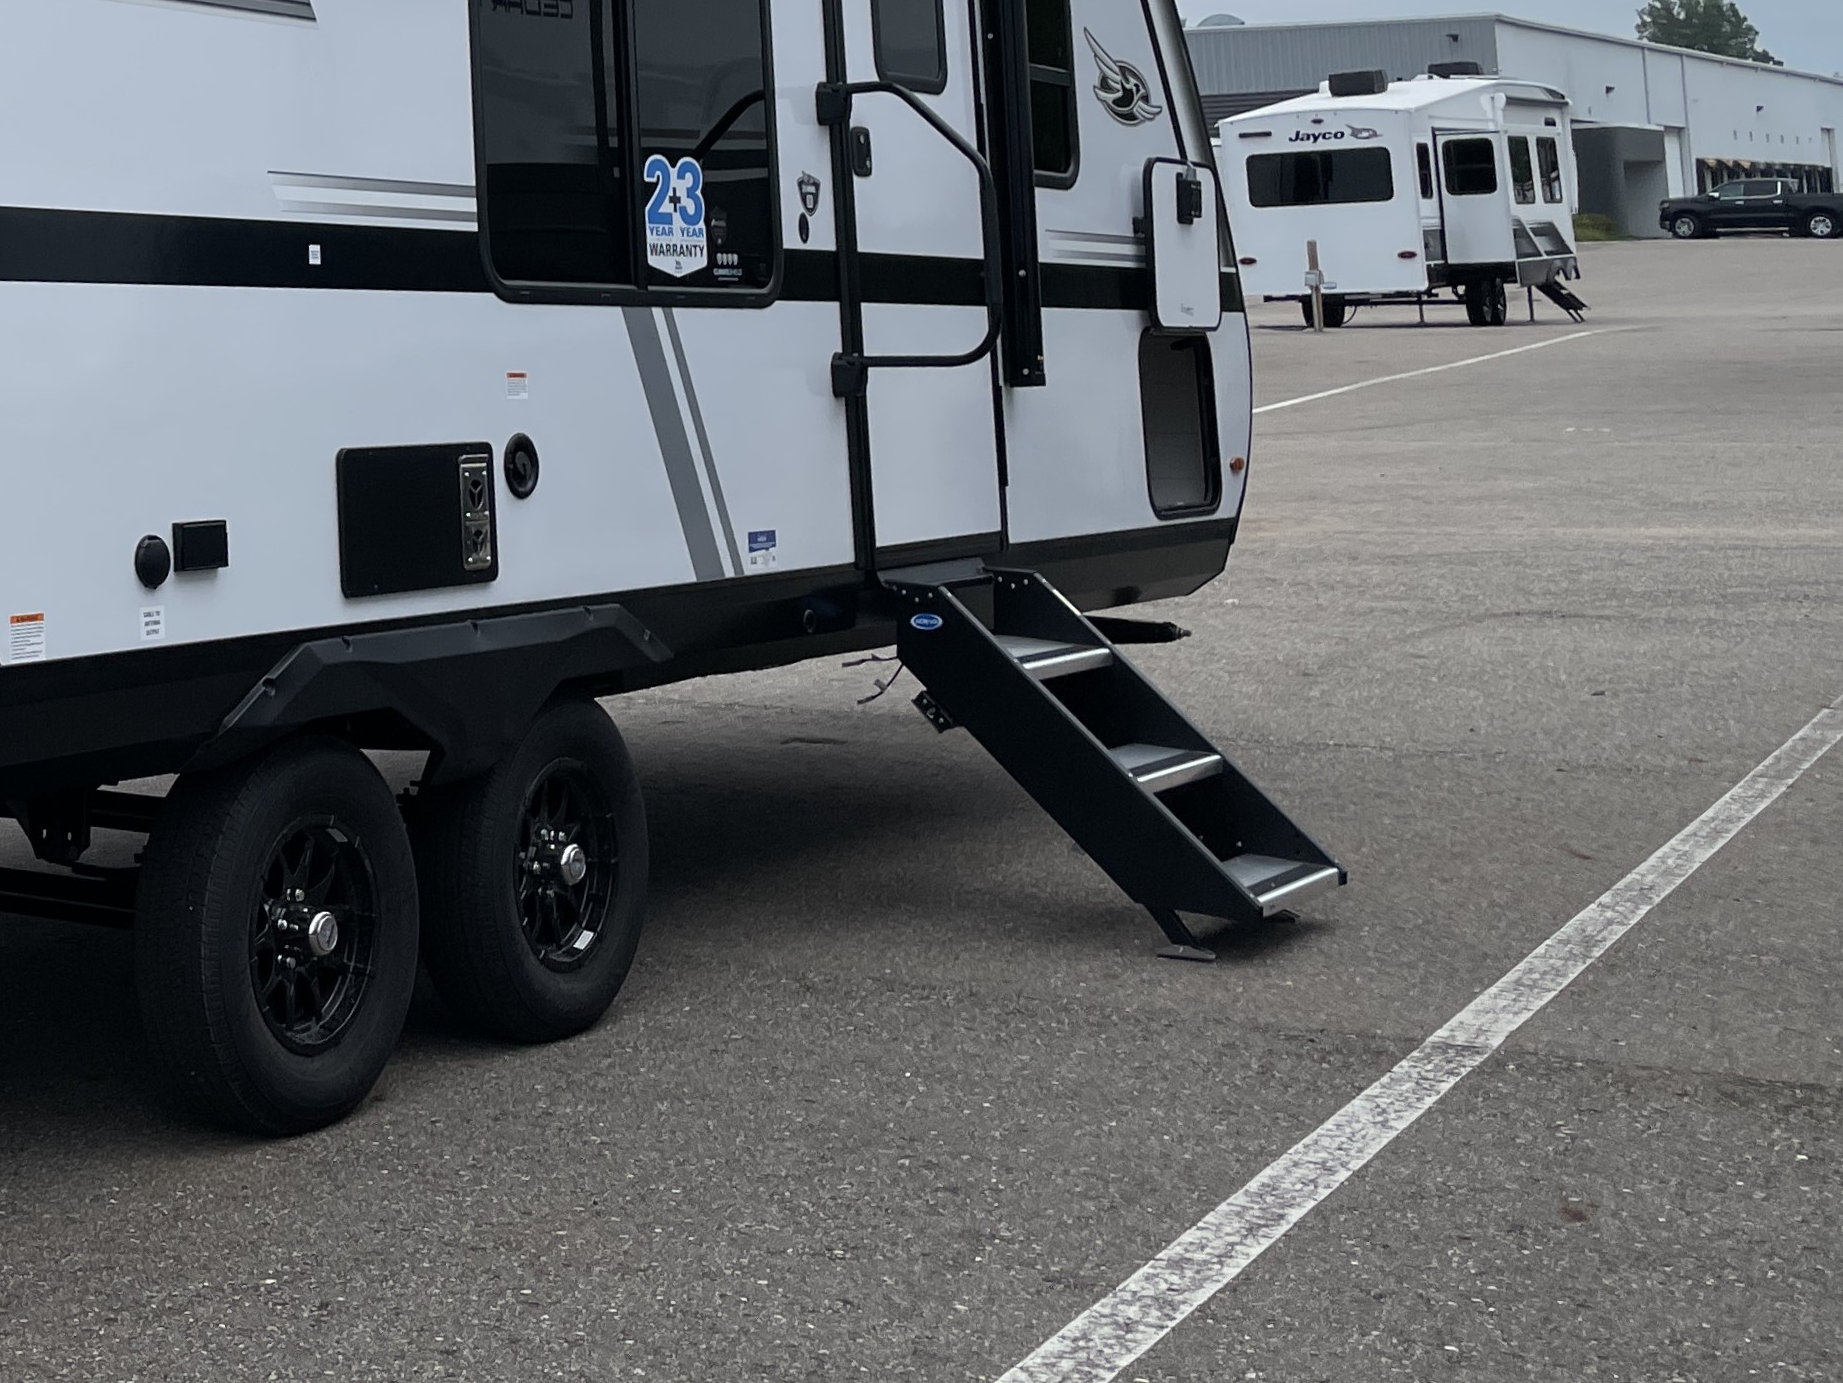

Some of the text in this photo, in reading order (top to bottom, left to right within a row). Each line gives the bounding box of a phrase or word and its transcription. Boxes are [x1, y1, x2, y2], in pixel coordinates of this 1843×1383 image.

[1288, 130, 1345, 143] Jayco
[648, 226, 705, 239] YEAR YEAR
[649, 243, 705, 258] WARRANTY
